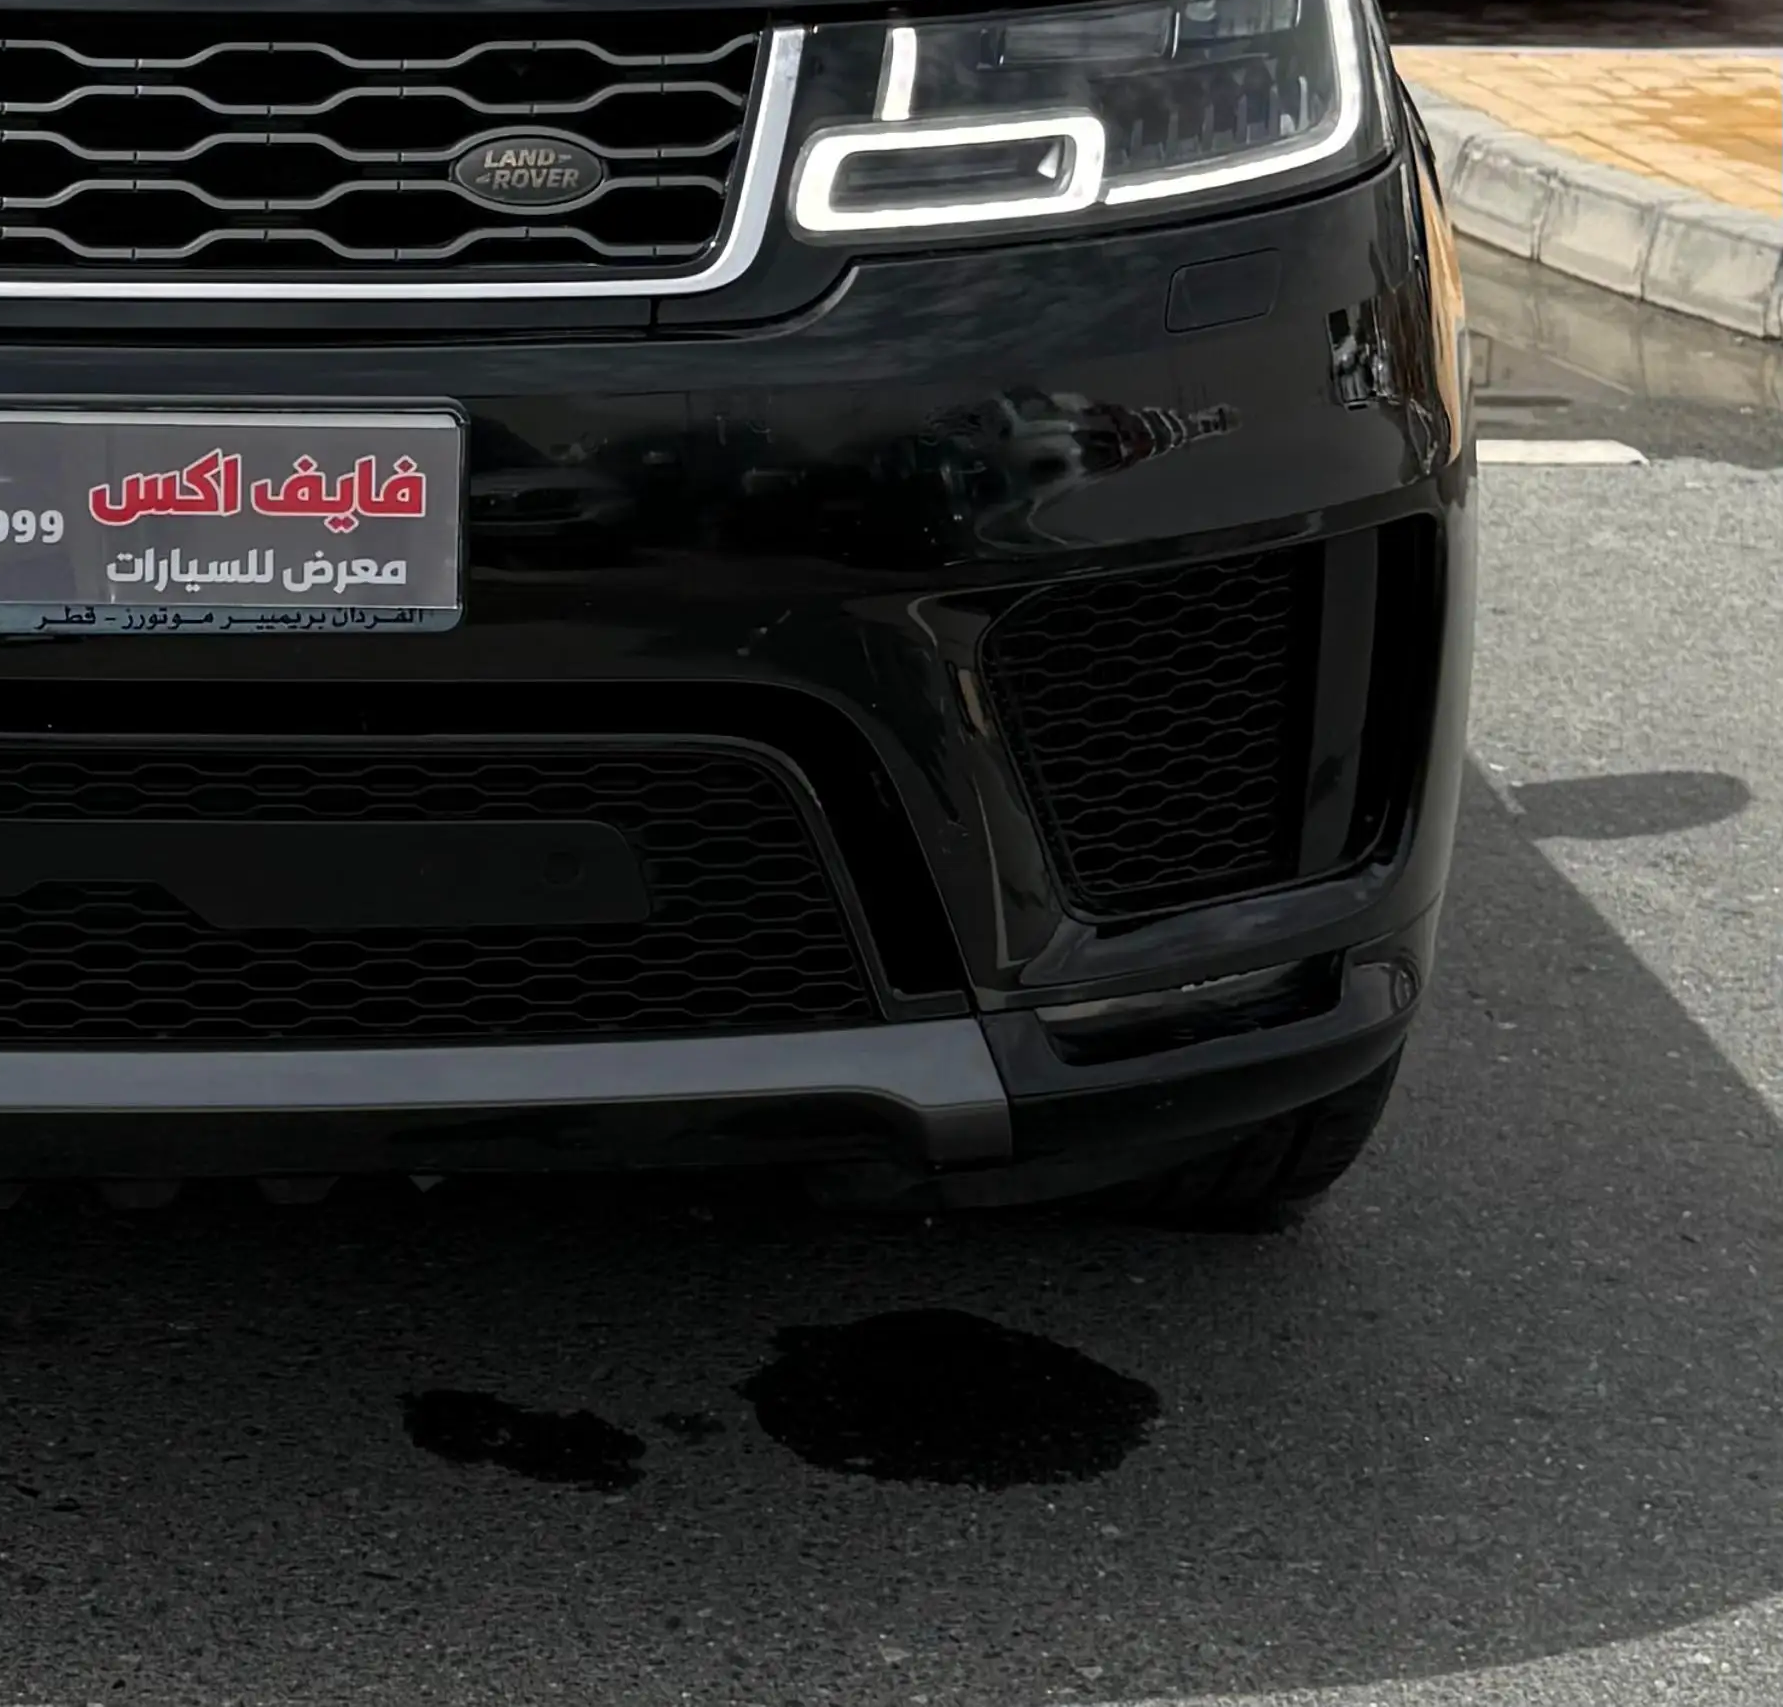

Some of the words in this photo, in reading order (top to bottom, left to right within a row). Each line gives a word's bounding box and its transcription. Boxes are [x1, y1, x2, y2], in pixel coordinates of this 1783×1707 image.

[483, 148, 556, 169] LAND
[491, 168, 580, 191] ROVER
[88, 447, 242, 527] اكس
[250, 454, 427, 534] فايف
[106, 547, 274, 594] للسيارات
[282, 550, 407, 594] معرض
[34, 605, 96, 630] قطر
